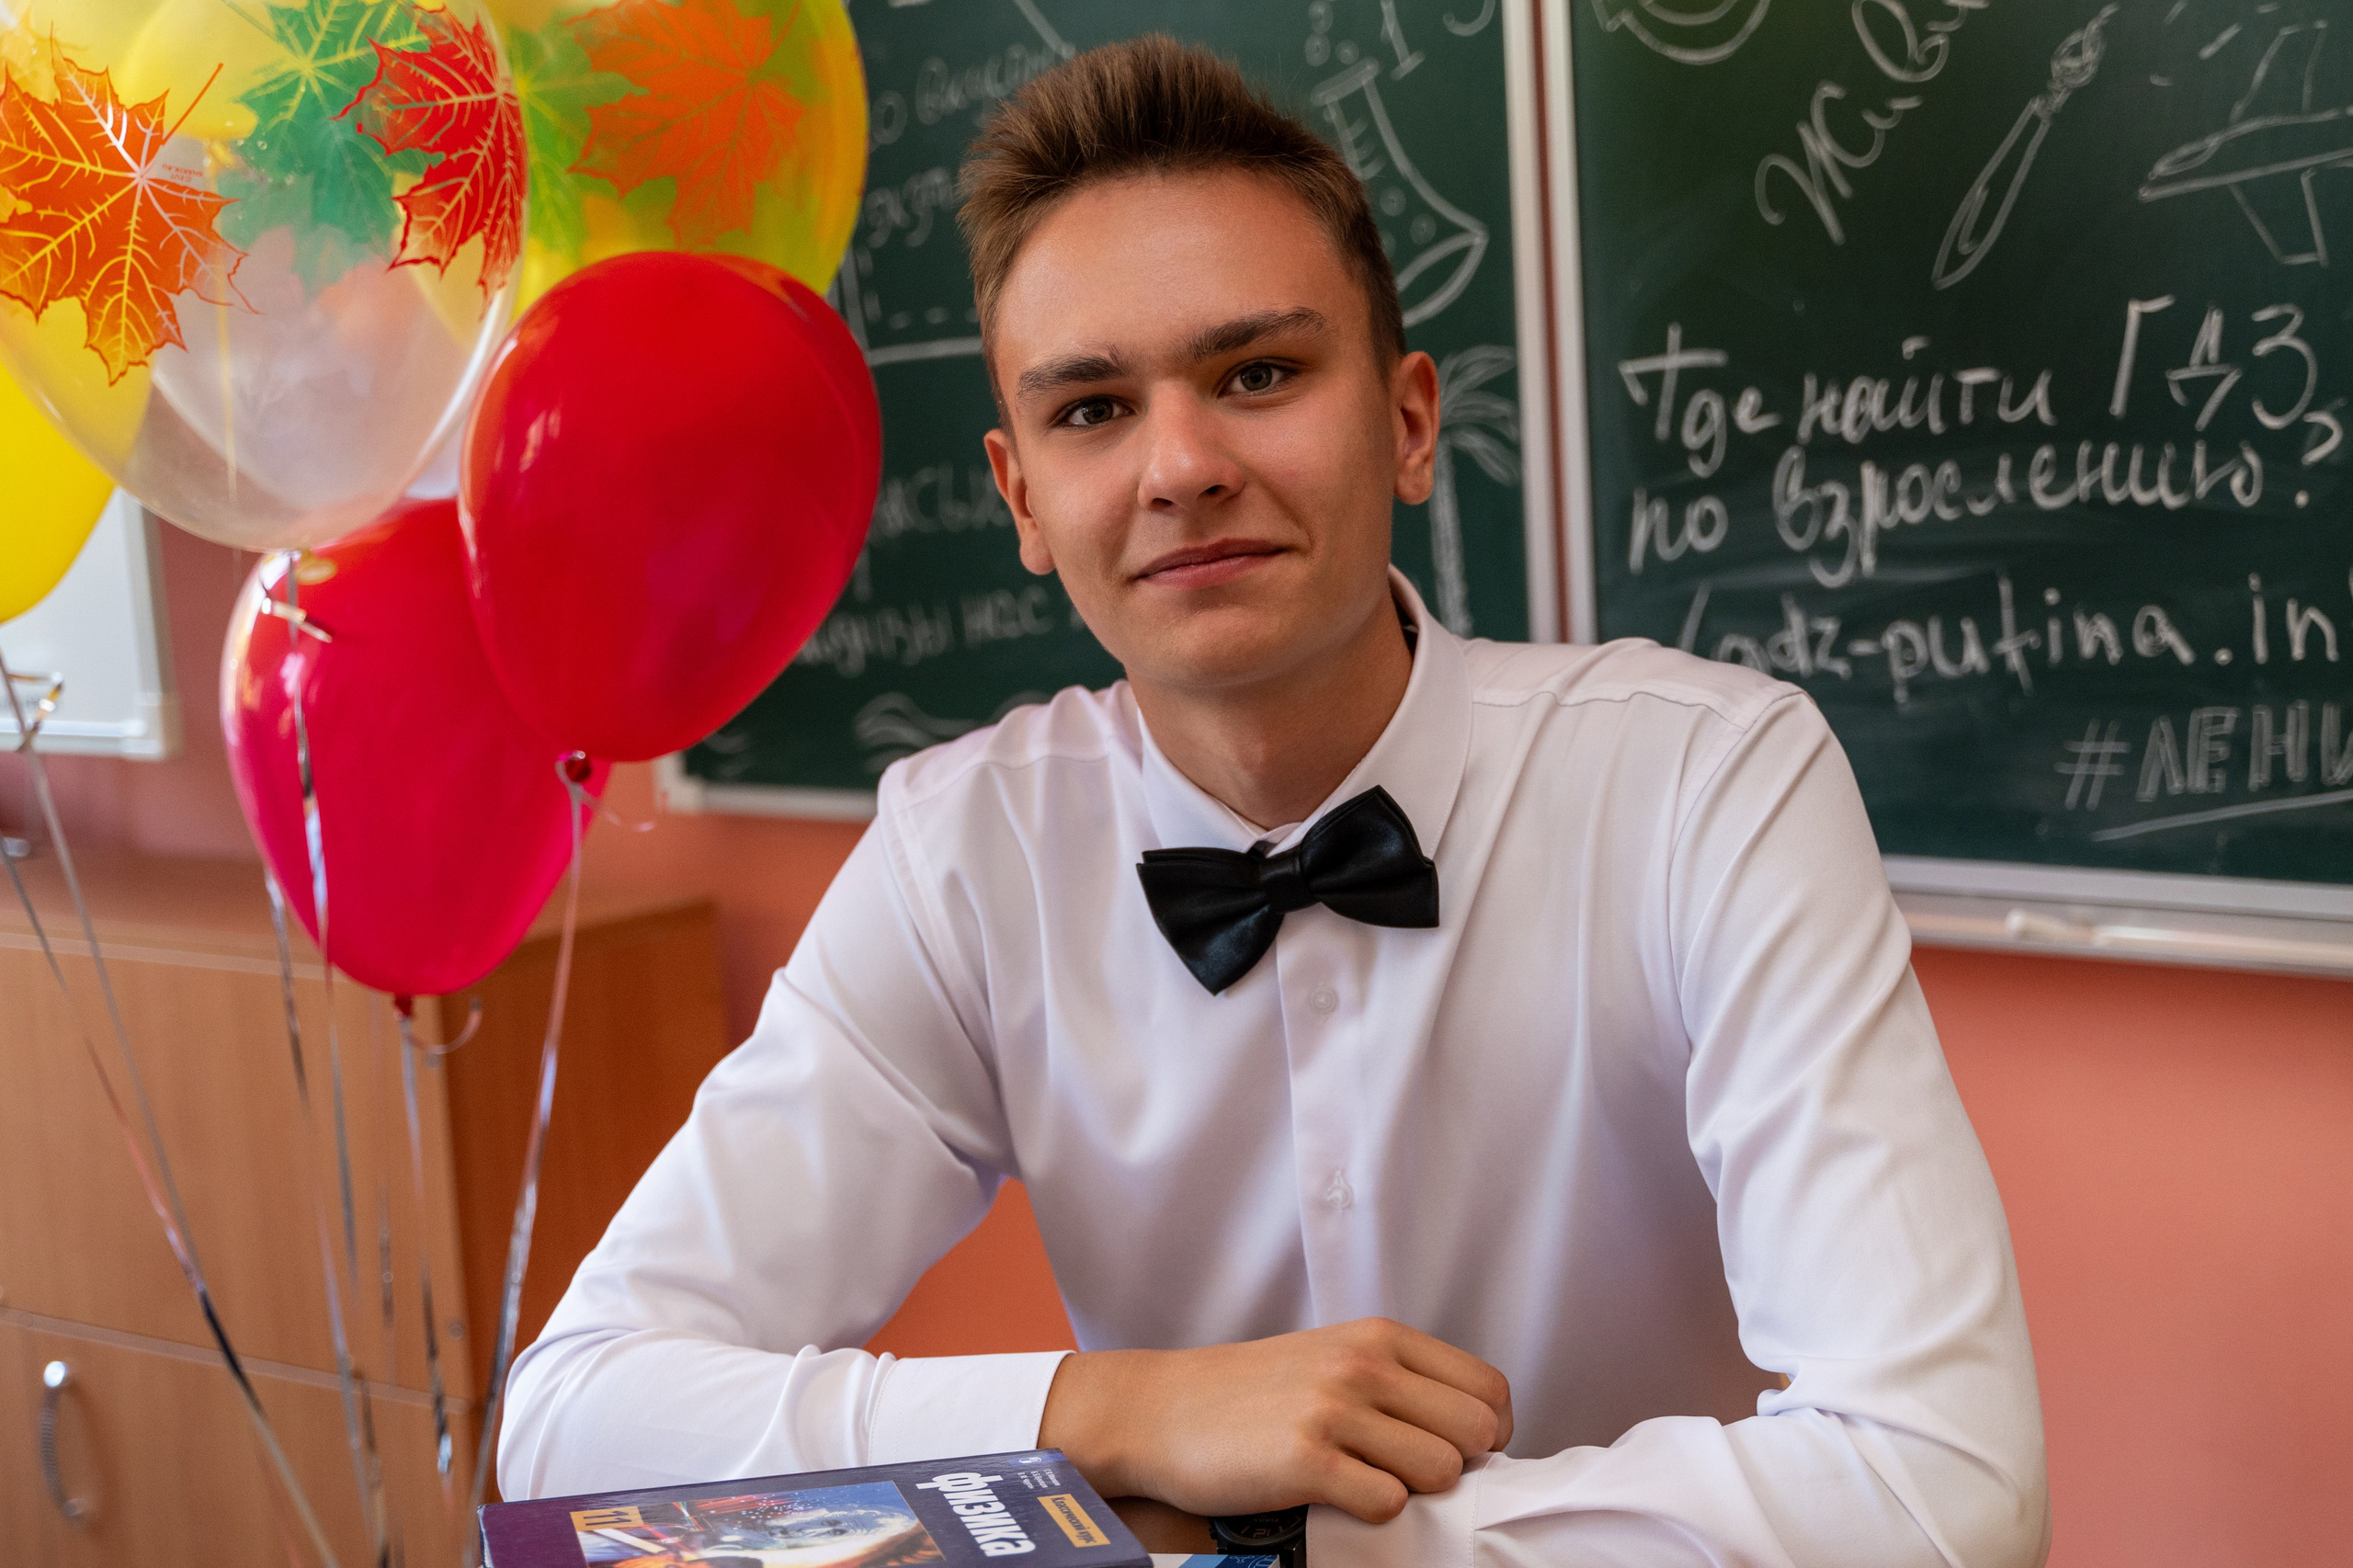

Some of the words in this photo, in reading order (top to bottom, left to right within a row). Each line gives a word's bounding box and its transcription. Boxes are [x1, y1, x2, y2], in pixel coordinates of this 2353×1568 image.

[1797, 335, 2059, 444] найти
[2109, 293, 2319, 432] ГДЗ
[1629, 488, 1728, 575] по
[583, 1510, 632, 1527] 11
